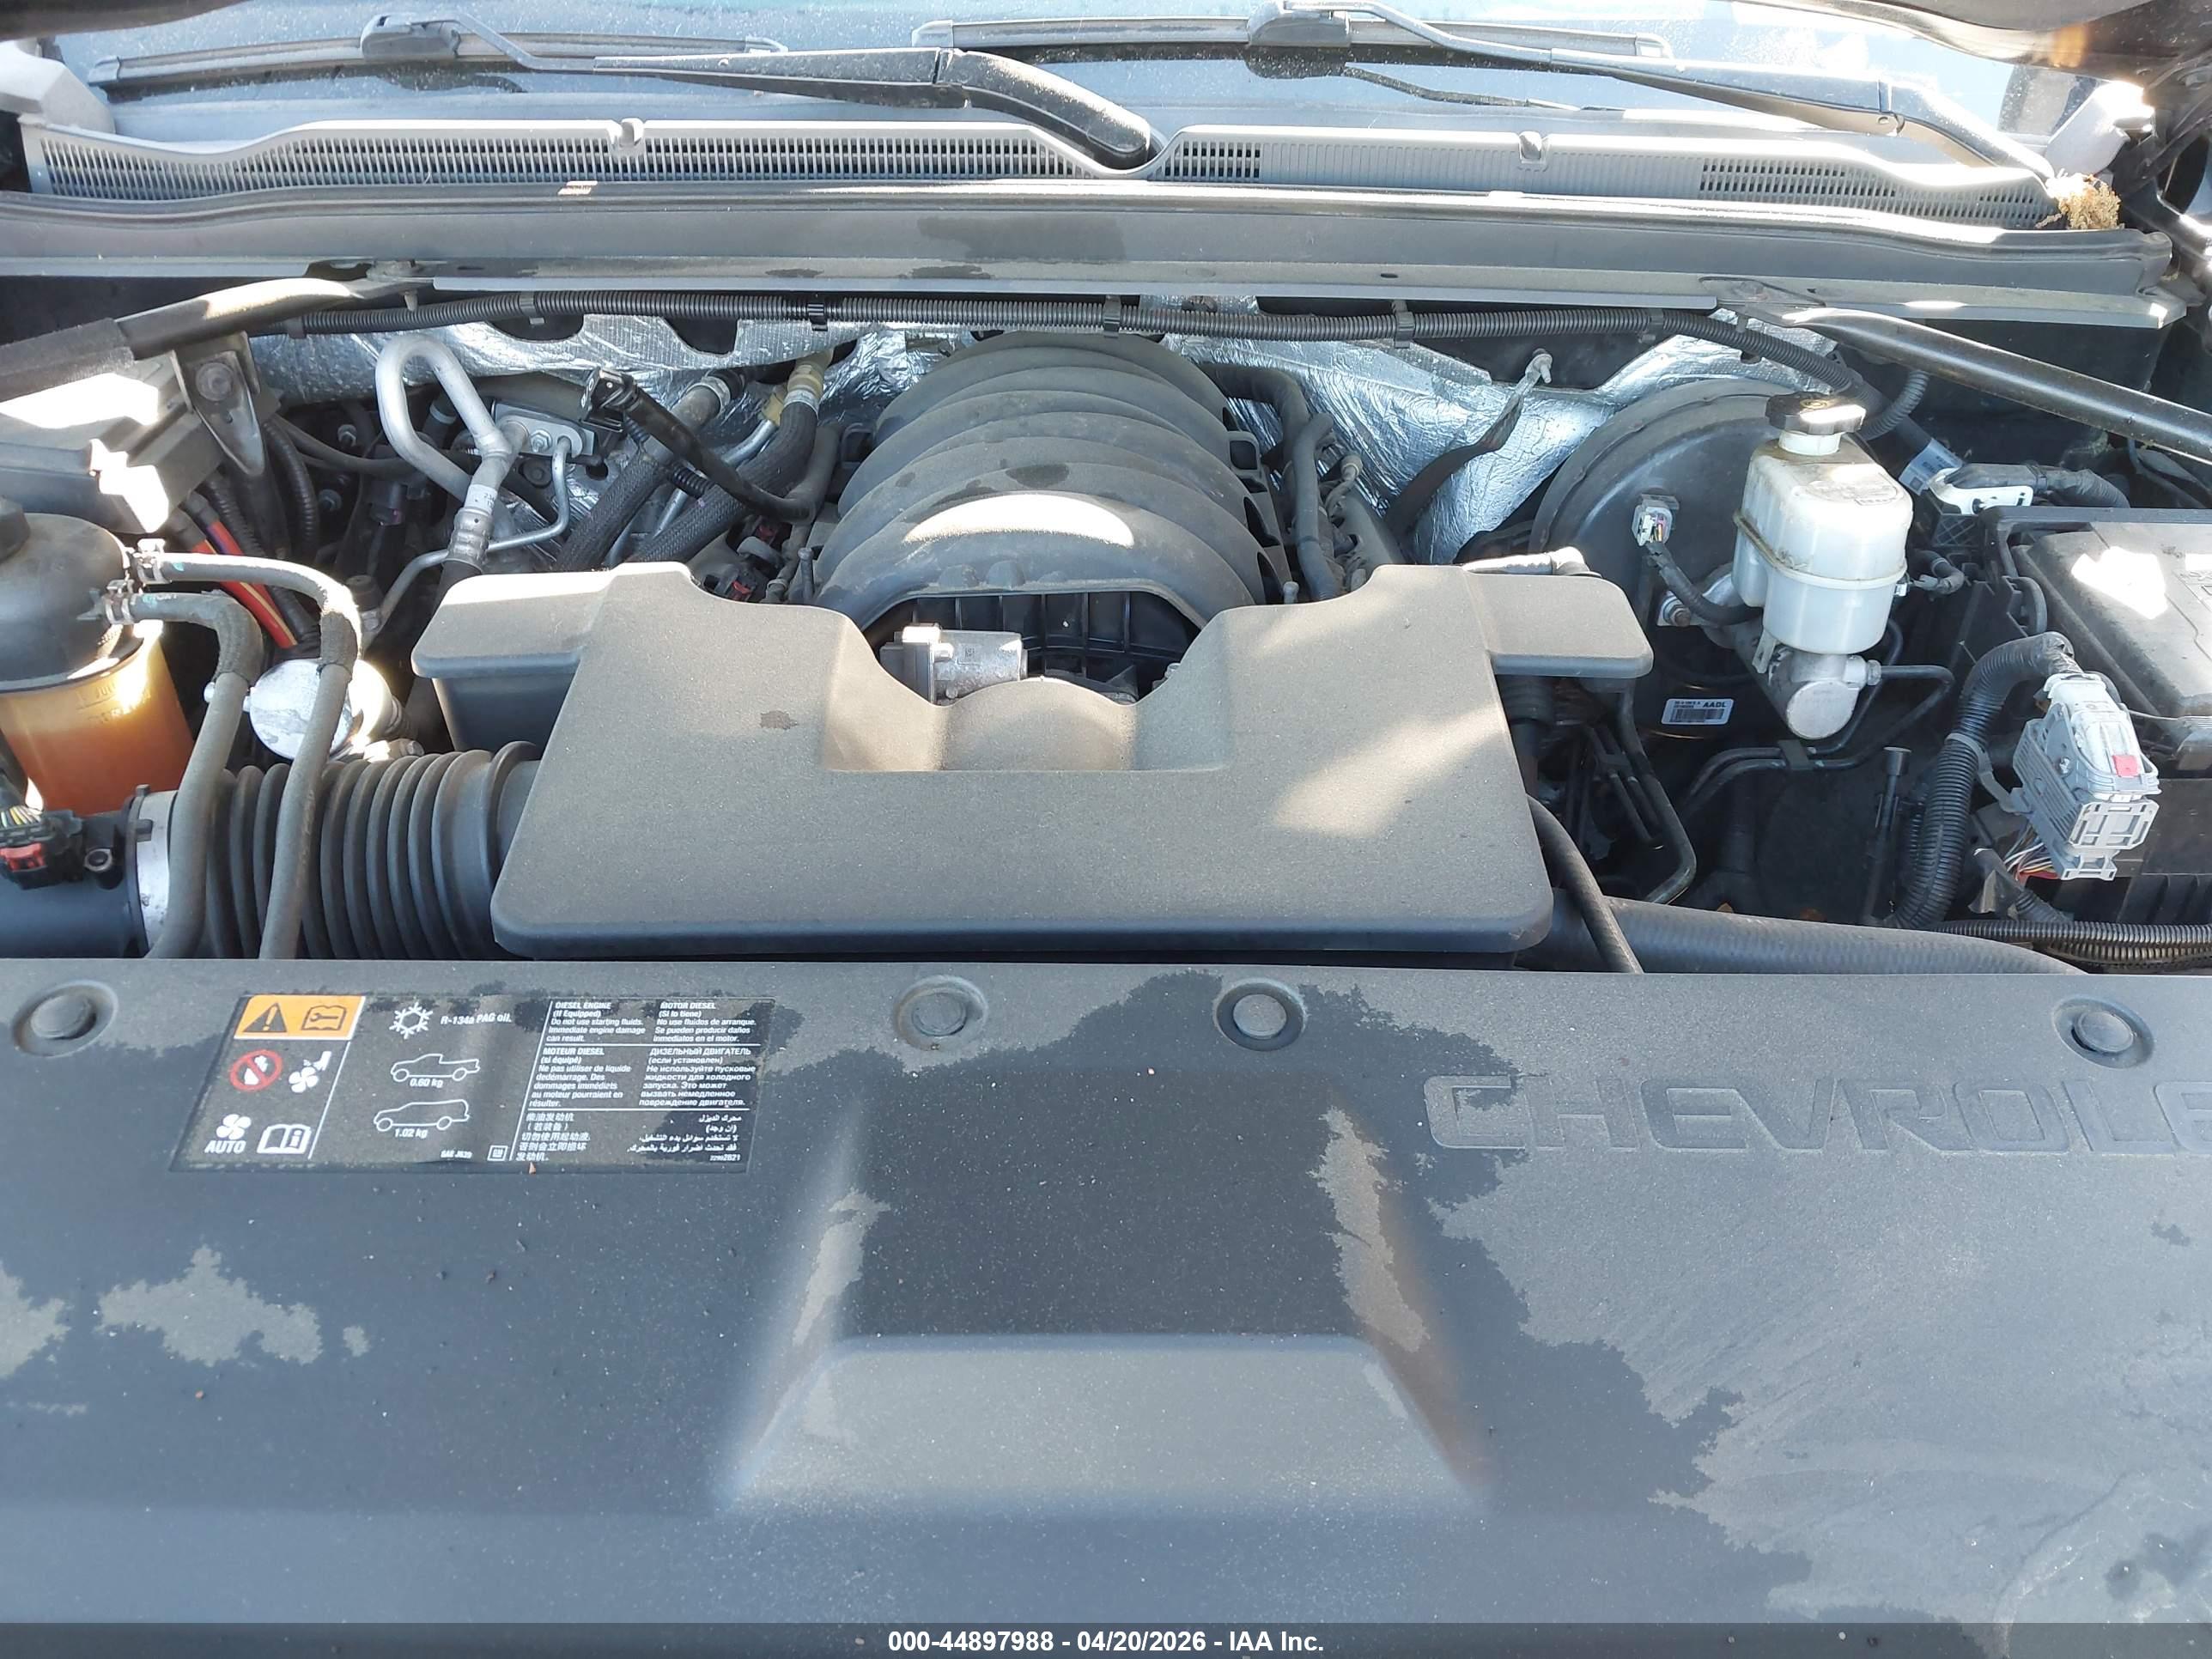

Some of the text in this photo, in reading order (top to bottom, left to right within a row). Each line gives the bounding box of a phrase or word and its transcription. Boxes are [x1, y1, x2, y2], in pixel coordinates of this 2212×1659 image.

[680, 1010, 702, 1018] tiene)
[440, 1013, 513, 1025] R-134a PAG oil.
[591, 1018, 620, 1027] starting
[649, 1047, 751, 1056] ДИЗЕЛЬНЫЙ ДВИГАТЕЛЬ
[648, 1056, 723, 1065] (если установлен)
[605, 1065, 632, 1073] liquide
[659, 1065, 713, 1073] используйте
[410, 1079, 443, 1088] 0.60 kg
[534, 1082, 576, 1091] dommages
[572, 1091, 611, 1099] pourraient
[395, 1128, 428, 1139] 1.02 kg
[204, 1140, 246, 1154] AUTO
